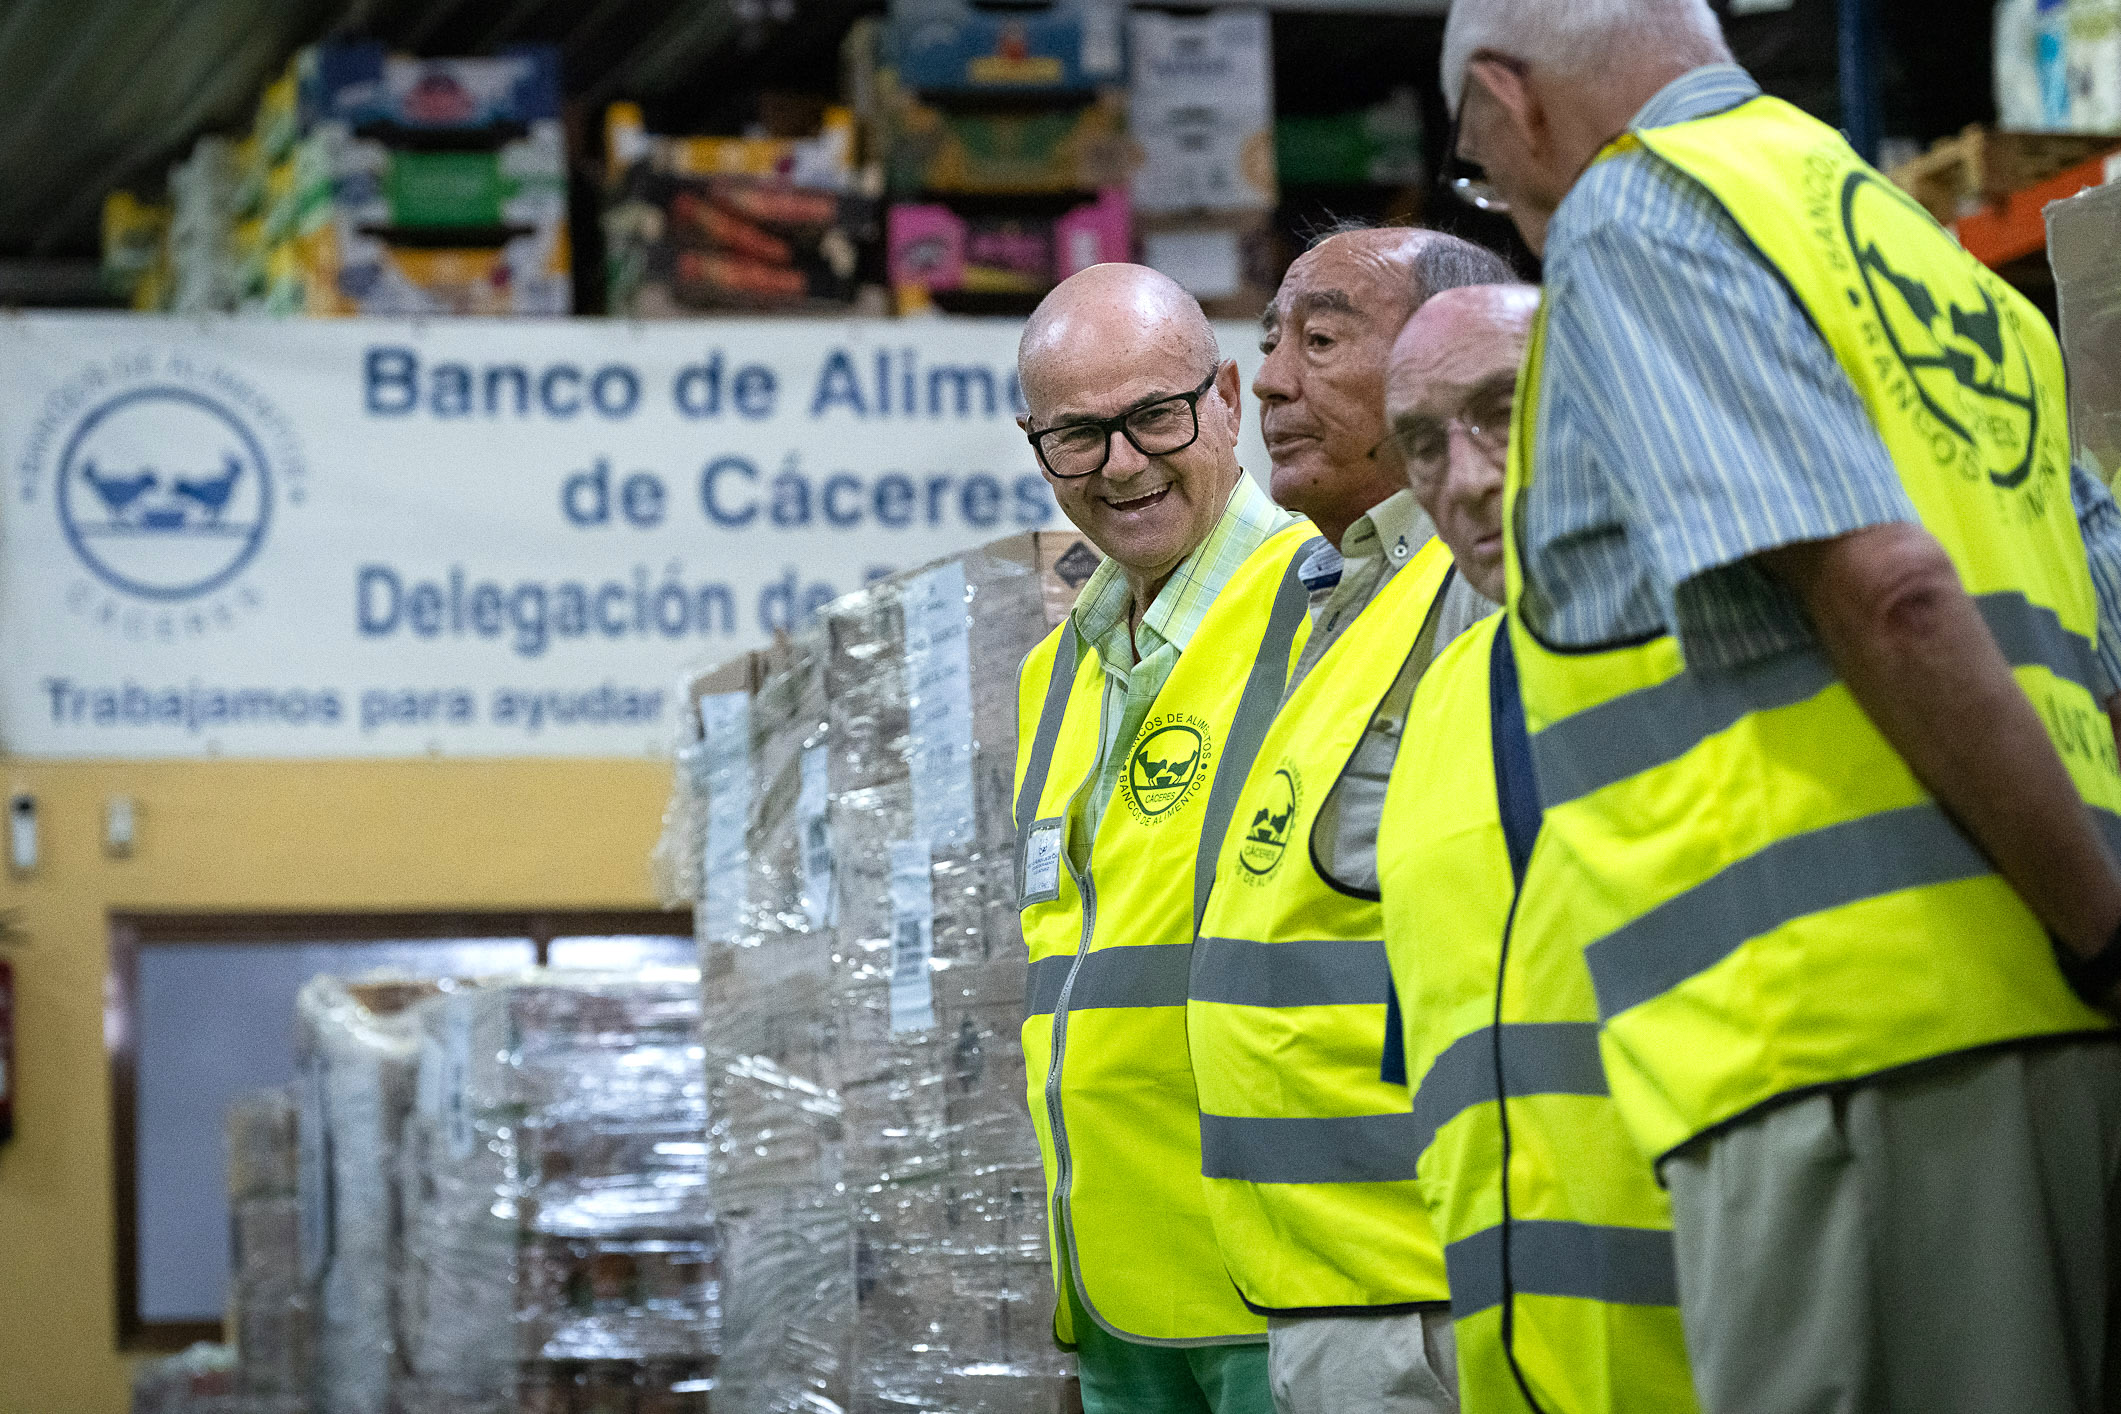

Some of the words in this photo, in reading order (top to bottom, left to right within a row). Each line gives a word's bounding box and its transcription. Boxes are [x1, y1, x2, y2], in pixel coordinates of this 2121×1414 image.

[366, 346, 641, 418] Banco
[674, 348, 778, 418] de
[561, 457, 667, 528] de
[700, 452, 1053, 528] Cáceres
[357, 560, 736, 658] Delegación
[43, 676, 343, 733] Trabajamos
[360, 686, 473, 733] para
[492, 680, 665, 733] ayudar
[1167, 713, 1183, 723] DE
[1185, 714, 1212, 760] ALIMENTOS
[1119, 774, 1142, 821] BANCOS
[1140, 815, 1152, 826] DE
[1152, 773, 1206, 826] ALIMENTOS
